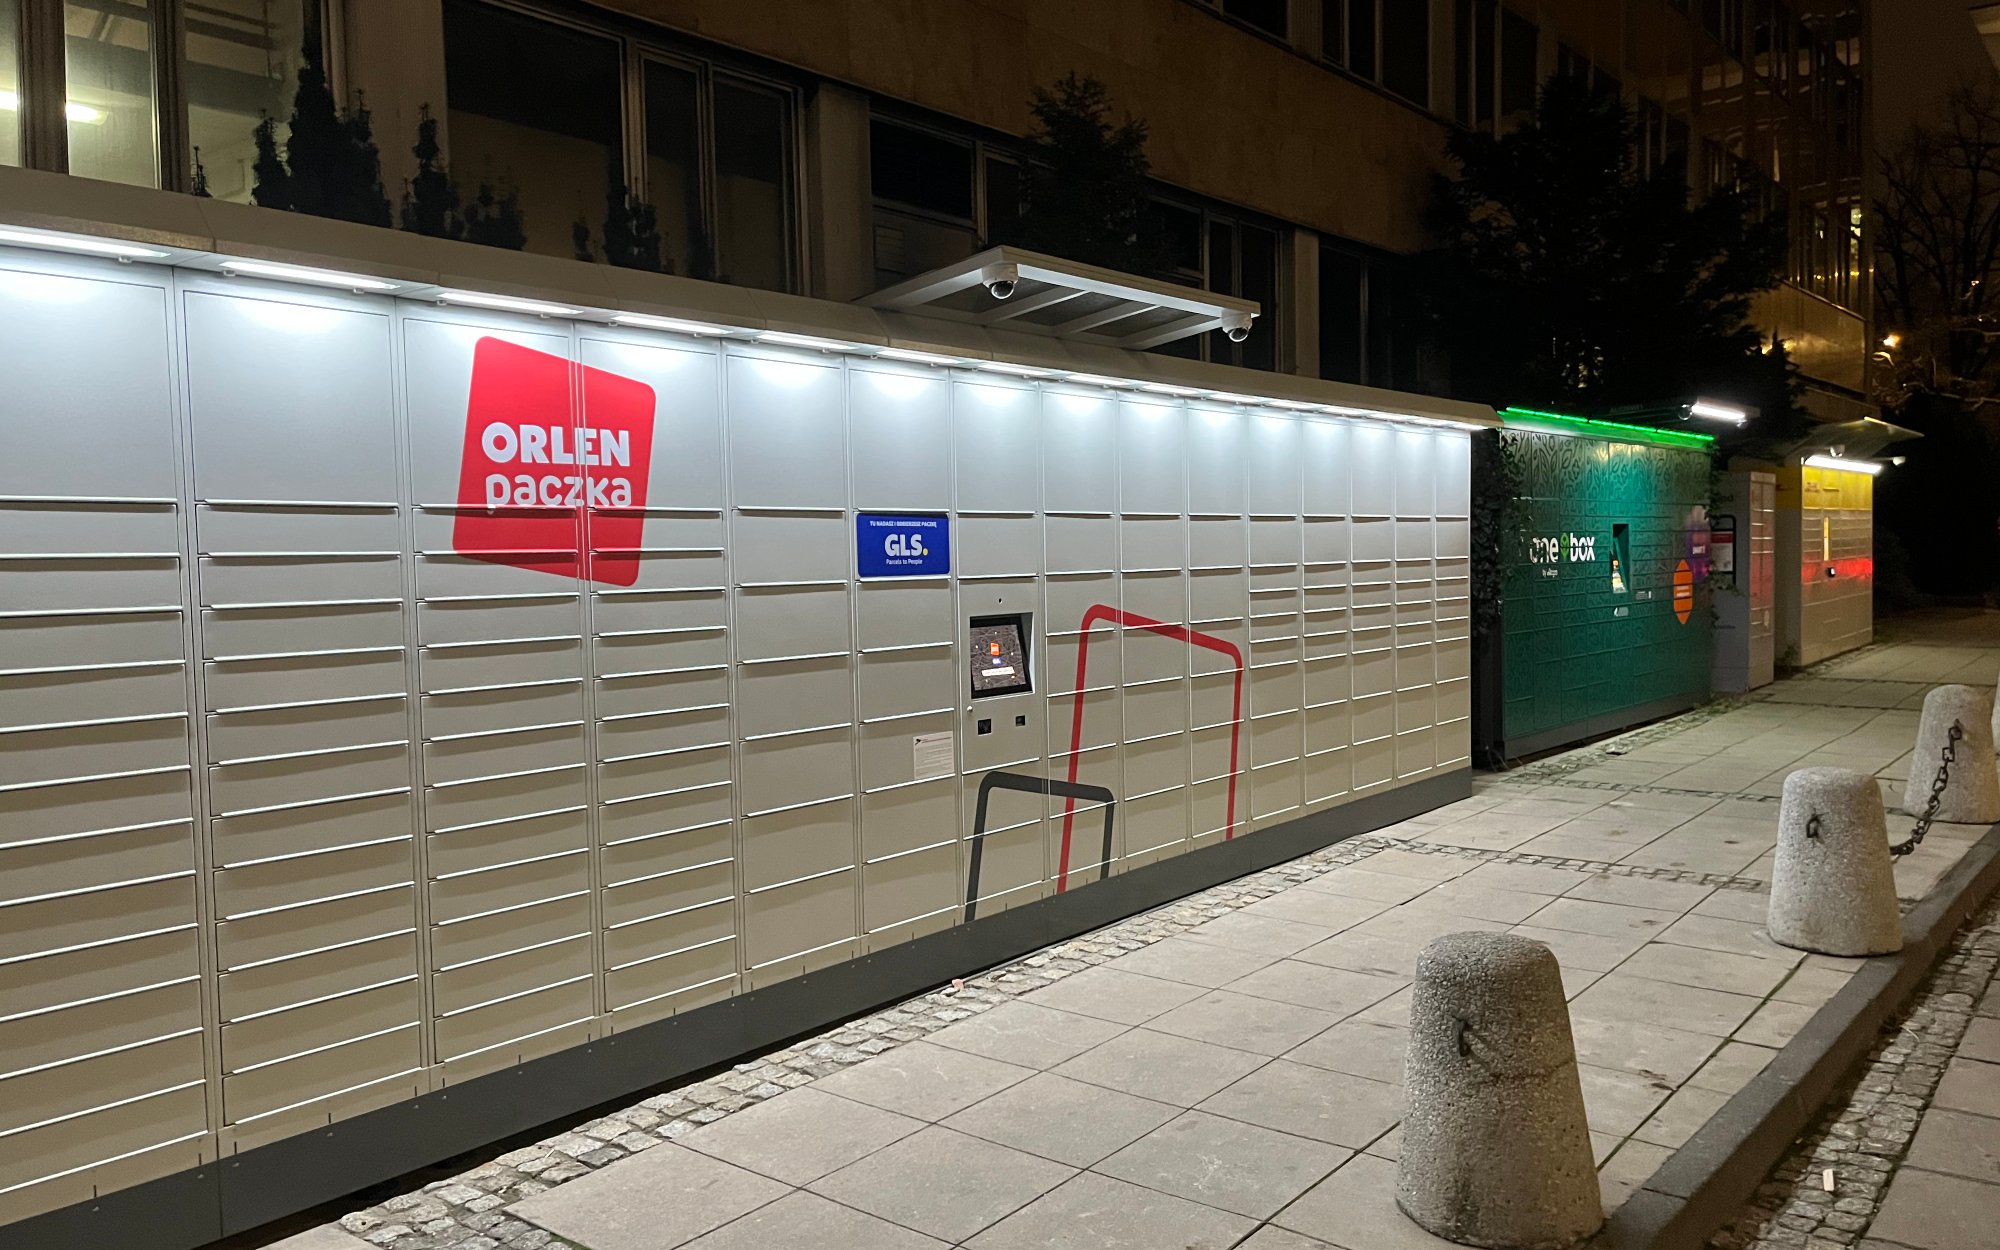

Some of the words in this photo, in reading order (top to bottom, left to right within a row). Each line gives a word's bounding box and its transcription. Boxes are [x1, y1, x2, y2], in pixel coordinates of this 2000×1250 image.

[481, 421, 631, 467] ORLEN
[485, 473, 632, 514] paczka
[1569, 532, 1596, 562] box
